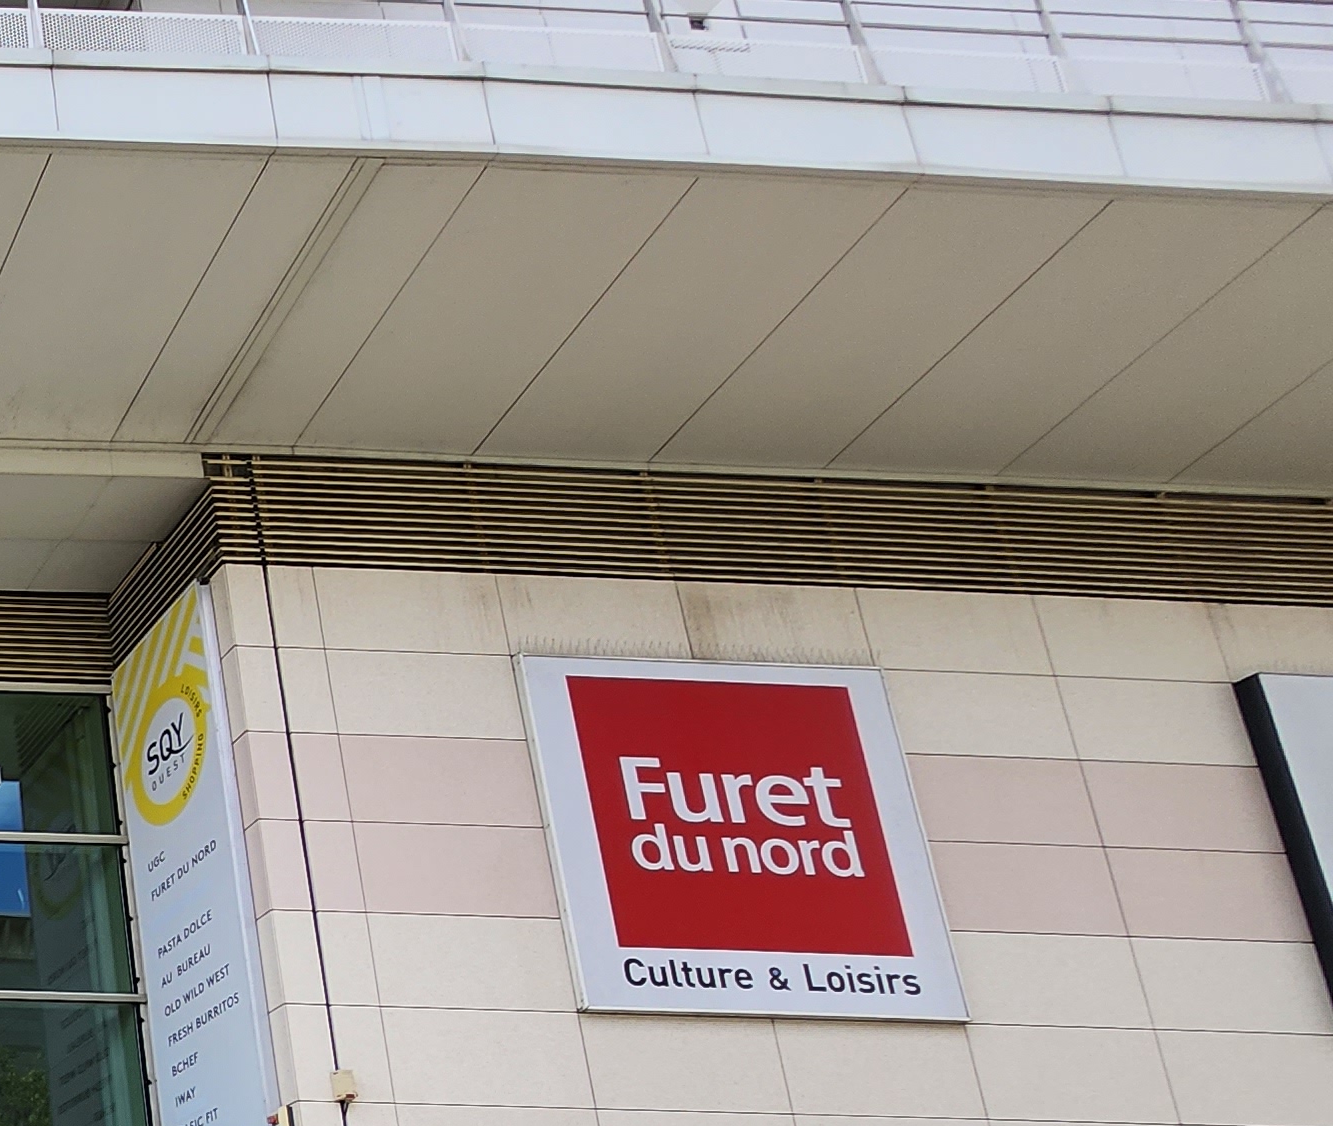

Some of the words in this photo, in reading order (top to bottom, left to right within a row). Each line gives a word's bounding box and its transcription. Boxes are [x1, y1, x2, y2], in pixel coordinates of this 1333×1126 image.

[180, 684, 202, 718] LOISIRS
[147, 712, 194, 775] SQY
[182, 733, 204, 800] SHOPPING
[152, 753, 185, 791] OUEST
[619, 756, 852, 828] Furet
[147, 851, 165, 872] UGC
[151, 873, 175, 901] FURET
[177, 862, 189, 879] DU
[191, 840, 217, 868] NORD
[632, 823, 713, 872] du
[721, 830, 865, 878] nord
[157, 934, 182, 959] PASTA
[183, 909, 212, 939] DOLCE
[161, 972, 172, 988] AU
[177, 943, 211, 976] BUREAU
[164, 998, 181, 1017] OLD
[182, 982, 204, 1004] WILD
[206, 963, 230, 987] WEST
[623, 957, 754, 990] Culture
[768, 967, 792, 991] &
[802, 963, 922, 996] Loisirs
[168, 1021, 193, 1047] FRESH
[196, 992, 239, 1029] BURRITOS
[171, 1052, 198, 1077] BCHEF
[175, 1086, 196, 1108] IWAY
